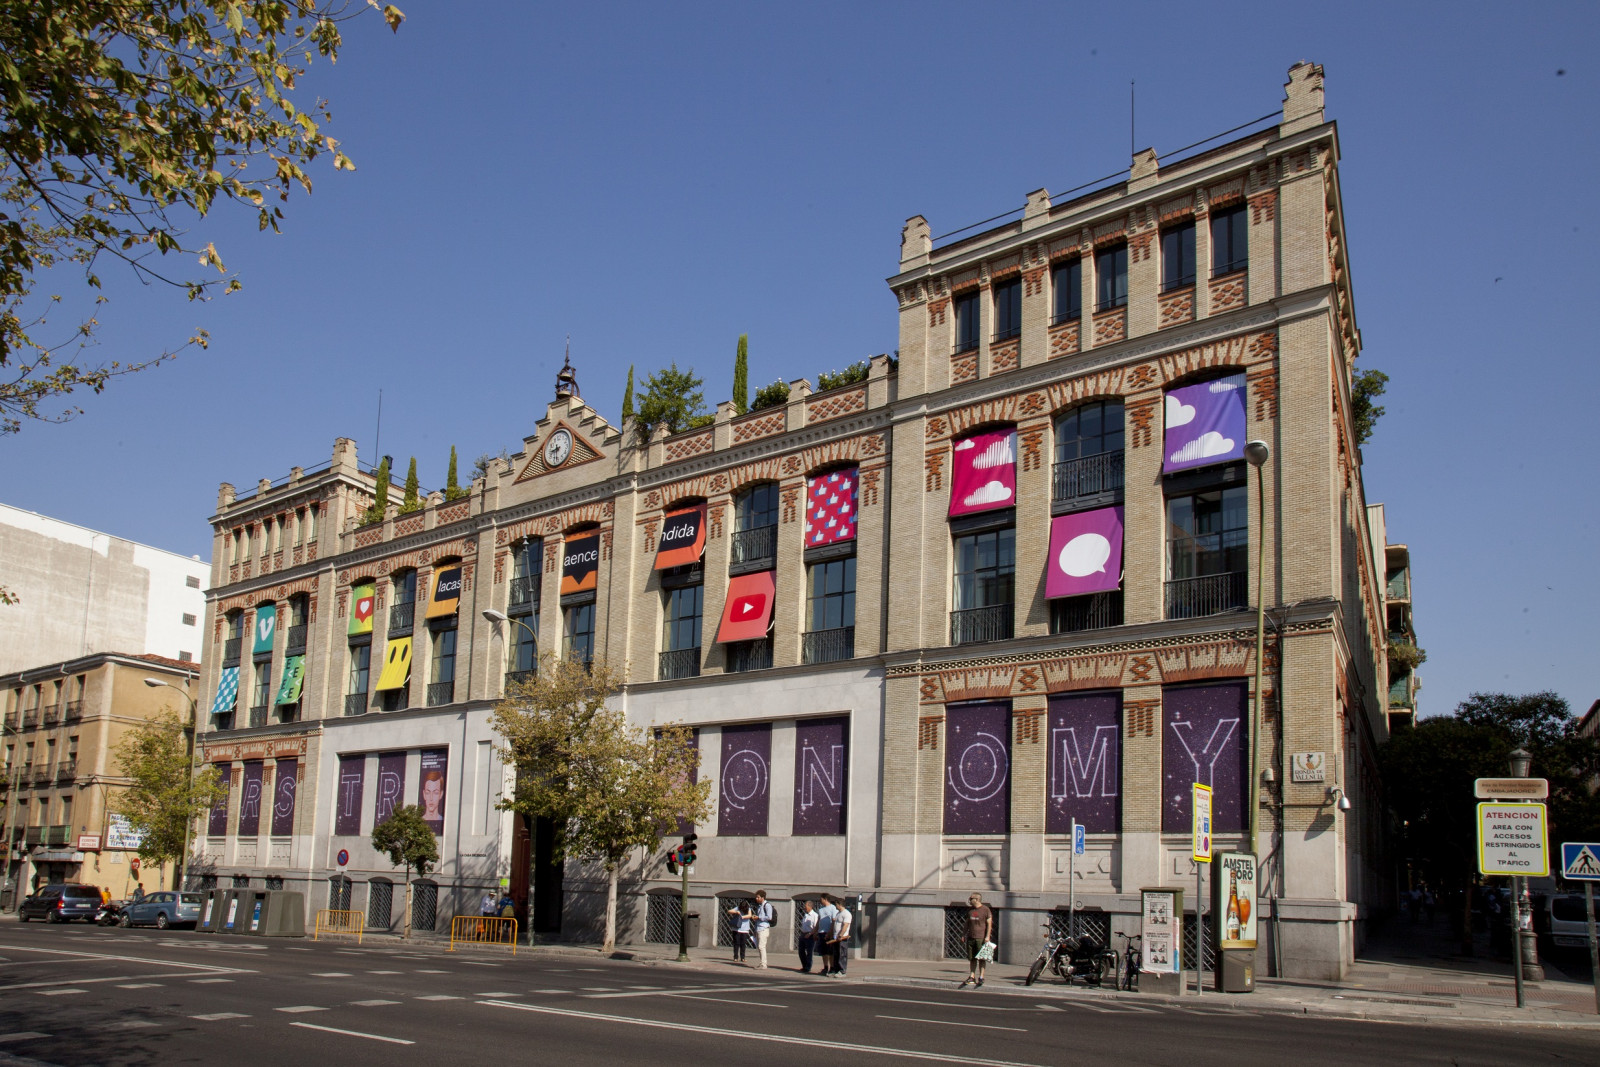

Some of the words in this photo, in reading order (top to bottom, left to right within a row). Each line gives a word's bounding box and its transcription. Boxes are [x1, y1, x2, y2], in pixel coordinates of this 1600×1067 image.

[564, 550, 598, 566] aence
[1078, 829, 1083, 843] P
[1223, 858, 1253, 870] AMSTEL
[1236, 869, 1253, 880] ORO
